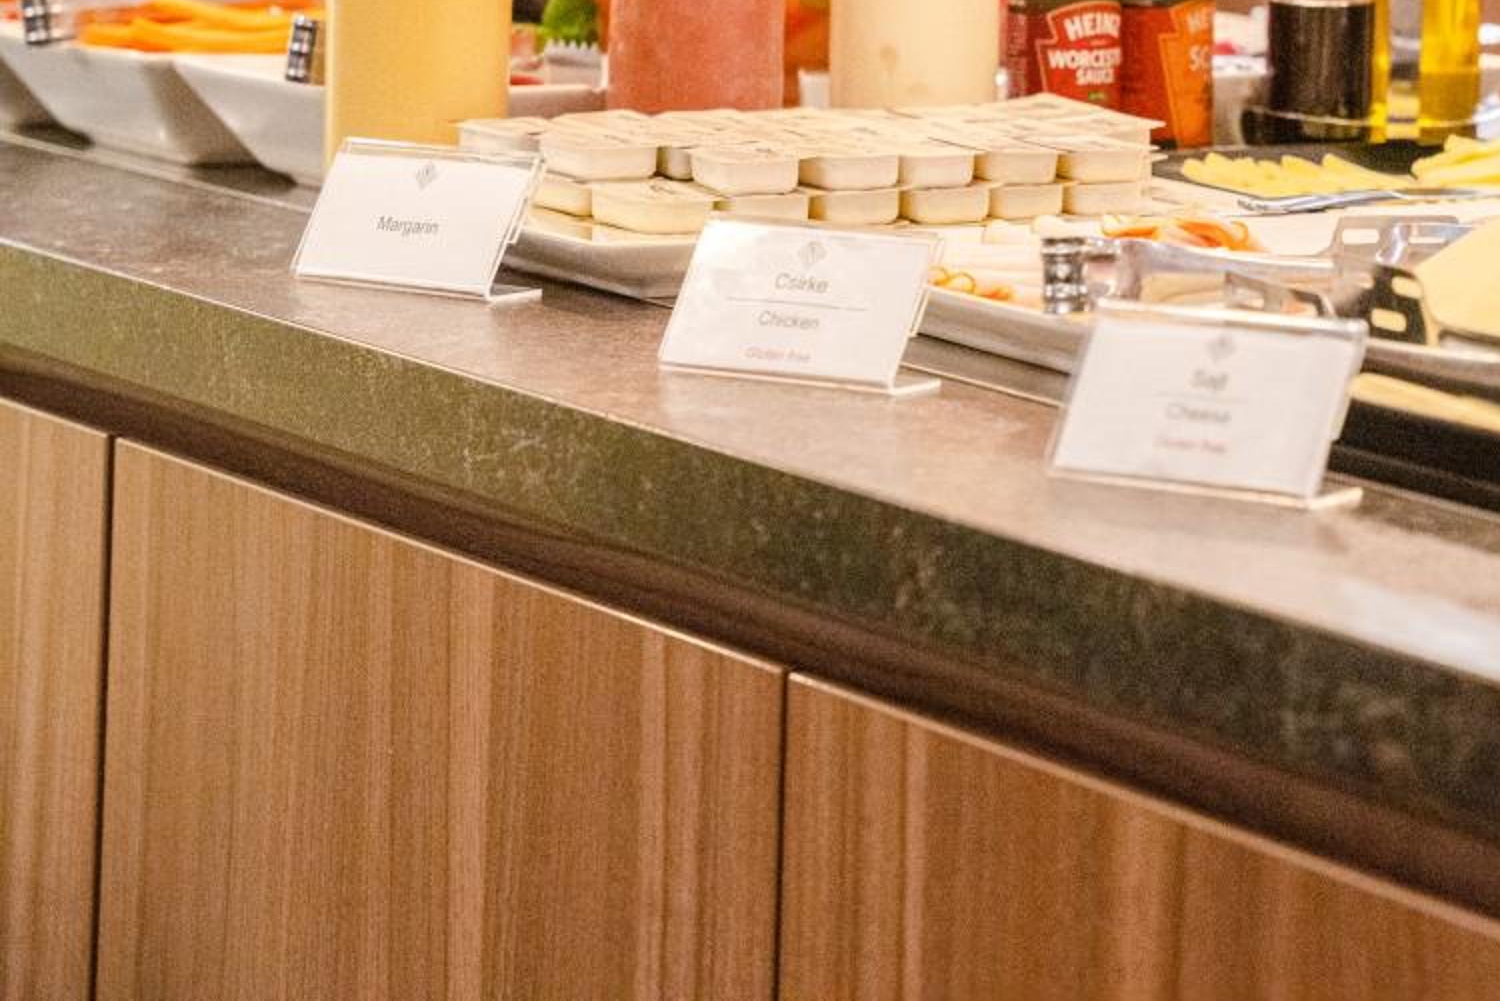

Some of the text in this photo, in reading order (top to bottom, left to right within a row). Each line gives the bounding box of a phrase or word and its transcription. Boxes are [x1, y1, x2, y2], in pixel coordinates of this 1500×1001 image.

[1064, 12, 1120, 41] HEIN
[376, 215, 439, 237] Margarin
[775, 272, 829, 294] Csirke
[758, 310, 820, 330] Chicken
